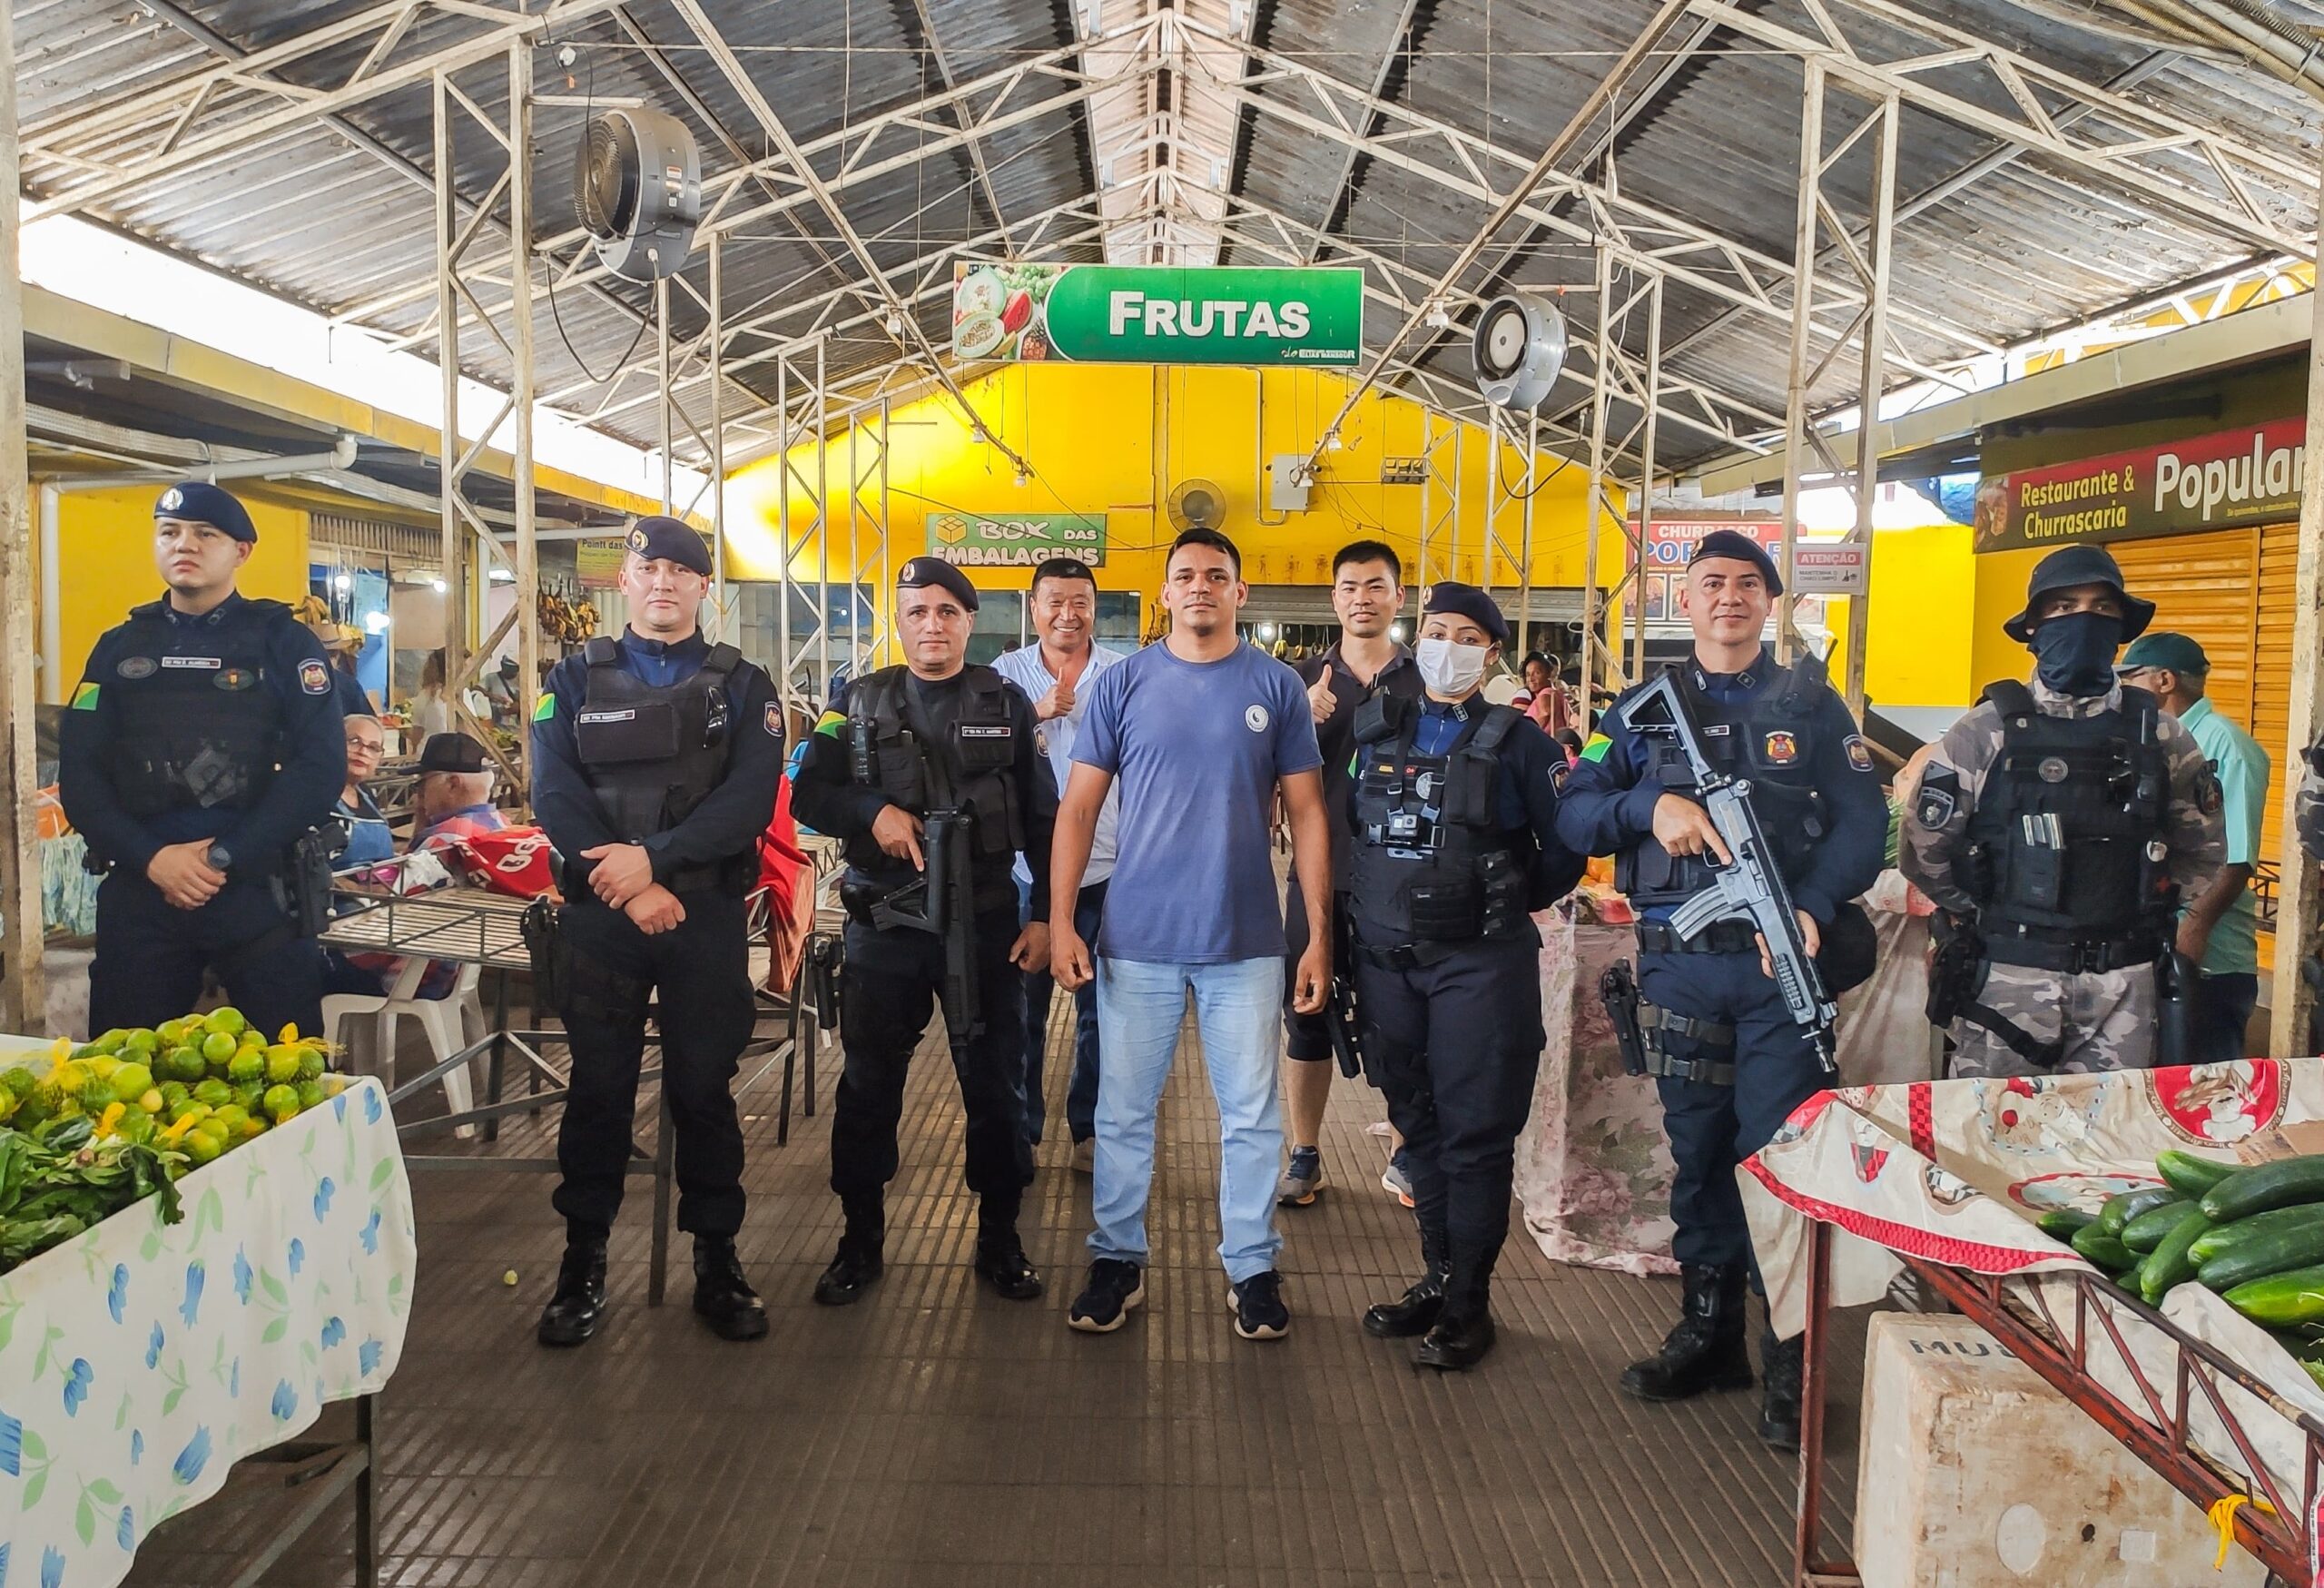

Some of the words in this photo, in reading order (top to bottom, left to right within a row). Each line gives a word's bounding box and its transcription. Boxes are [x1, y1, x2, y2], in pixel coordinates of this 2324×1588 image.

[1109, 291, 1311, 338] FRUTAS
[2021, 469, 2118, 508] Restaurante
[2122, 464, 2135, 492] &
[976, 521, 1053, 540] BOX
[1063, 530, 1098, 540] DAS
[2024, 499, 2127, 539] Churrascaria
[608, 540, 623, 550] das
